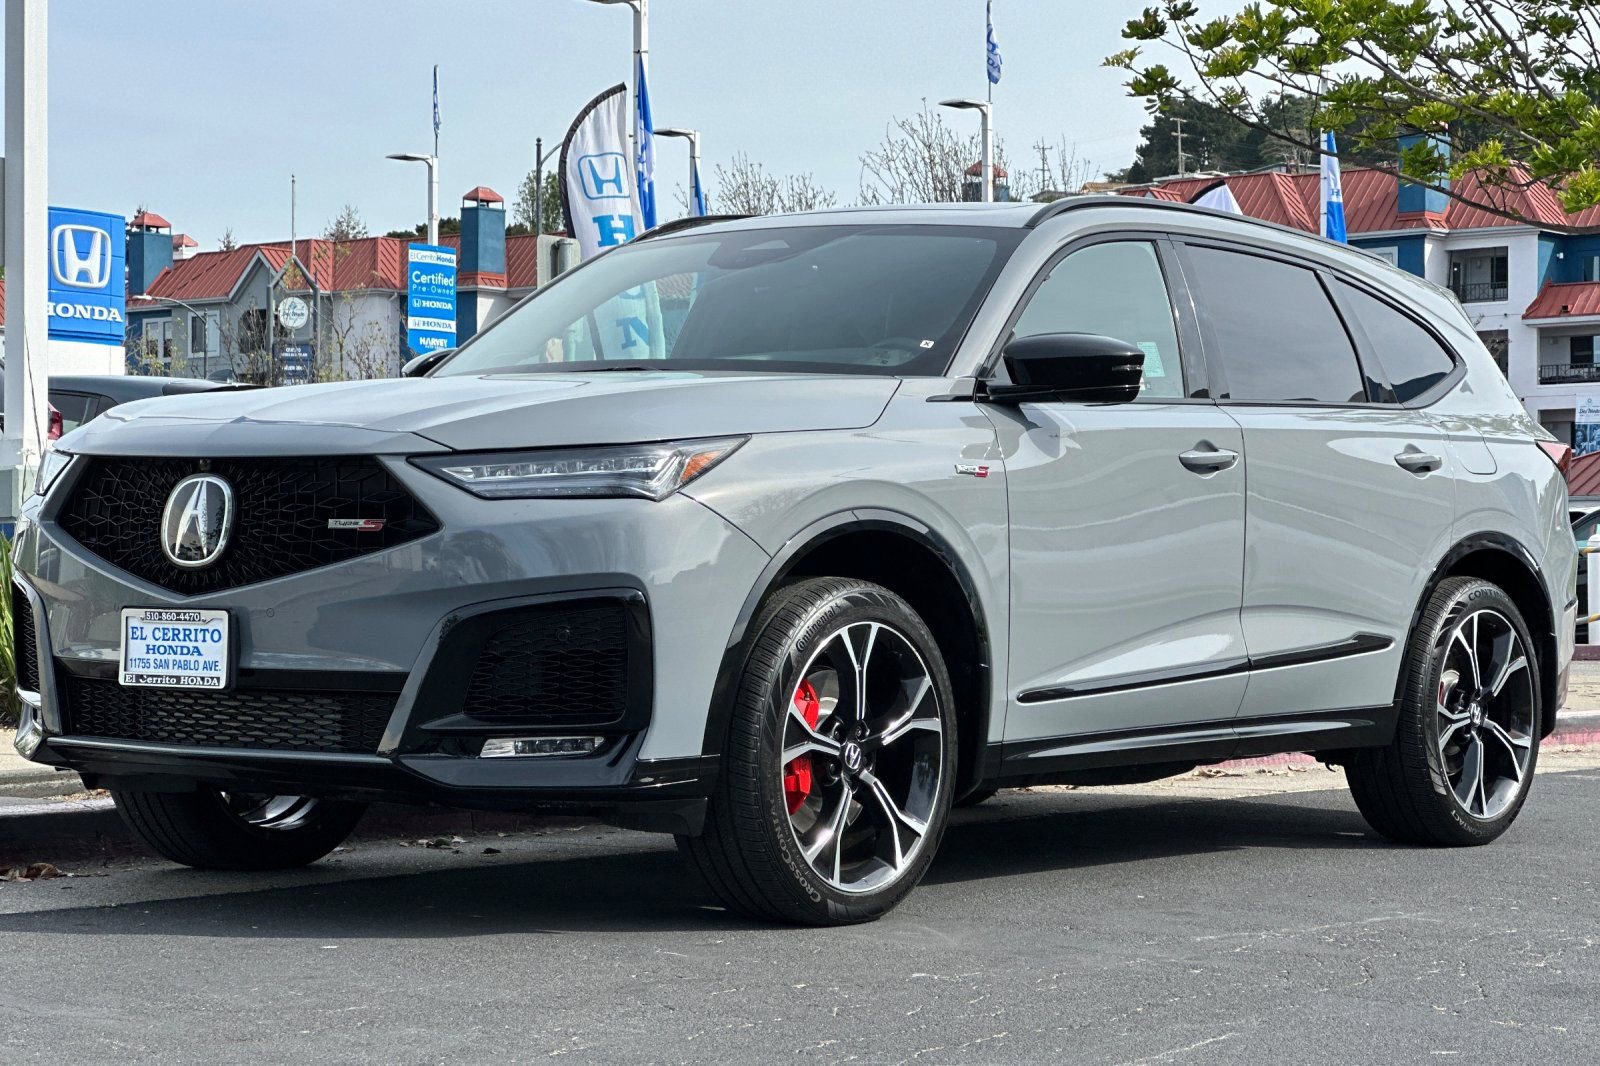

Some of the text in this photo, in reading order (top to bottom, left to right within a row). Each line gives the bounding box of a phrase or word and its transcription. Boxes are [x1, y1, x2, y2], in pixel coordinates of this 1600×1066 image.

[412, 271, 454, 287] Certified
[412, 285, 454, 296] Pre-Owned
[422, 300, 453, 310] HONDA
[422, 320, 452, 330] HONDA
[419, 336, 448, 348] HARVEY
[145, 611, 200, 621] 510-860-4470
[130, 626, 222, 643] EL CERRITO
[145, 644, 203, 656] HONDA
[130, 658, 221, 671] 11755 SAN PABLO AVE.
[125, 674, 136, 683] El
[180, 676, 219, 686] HONDA
